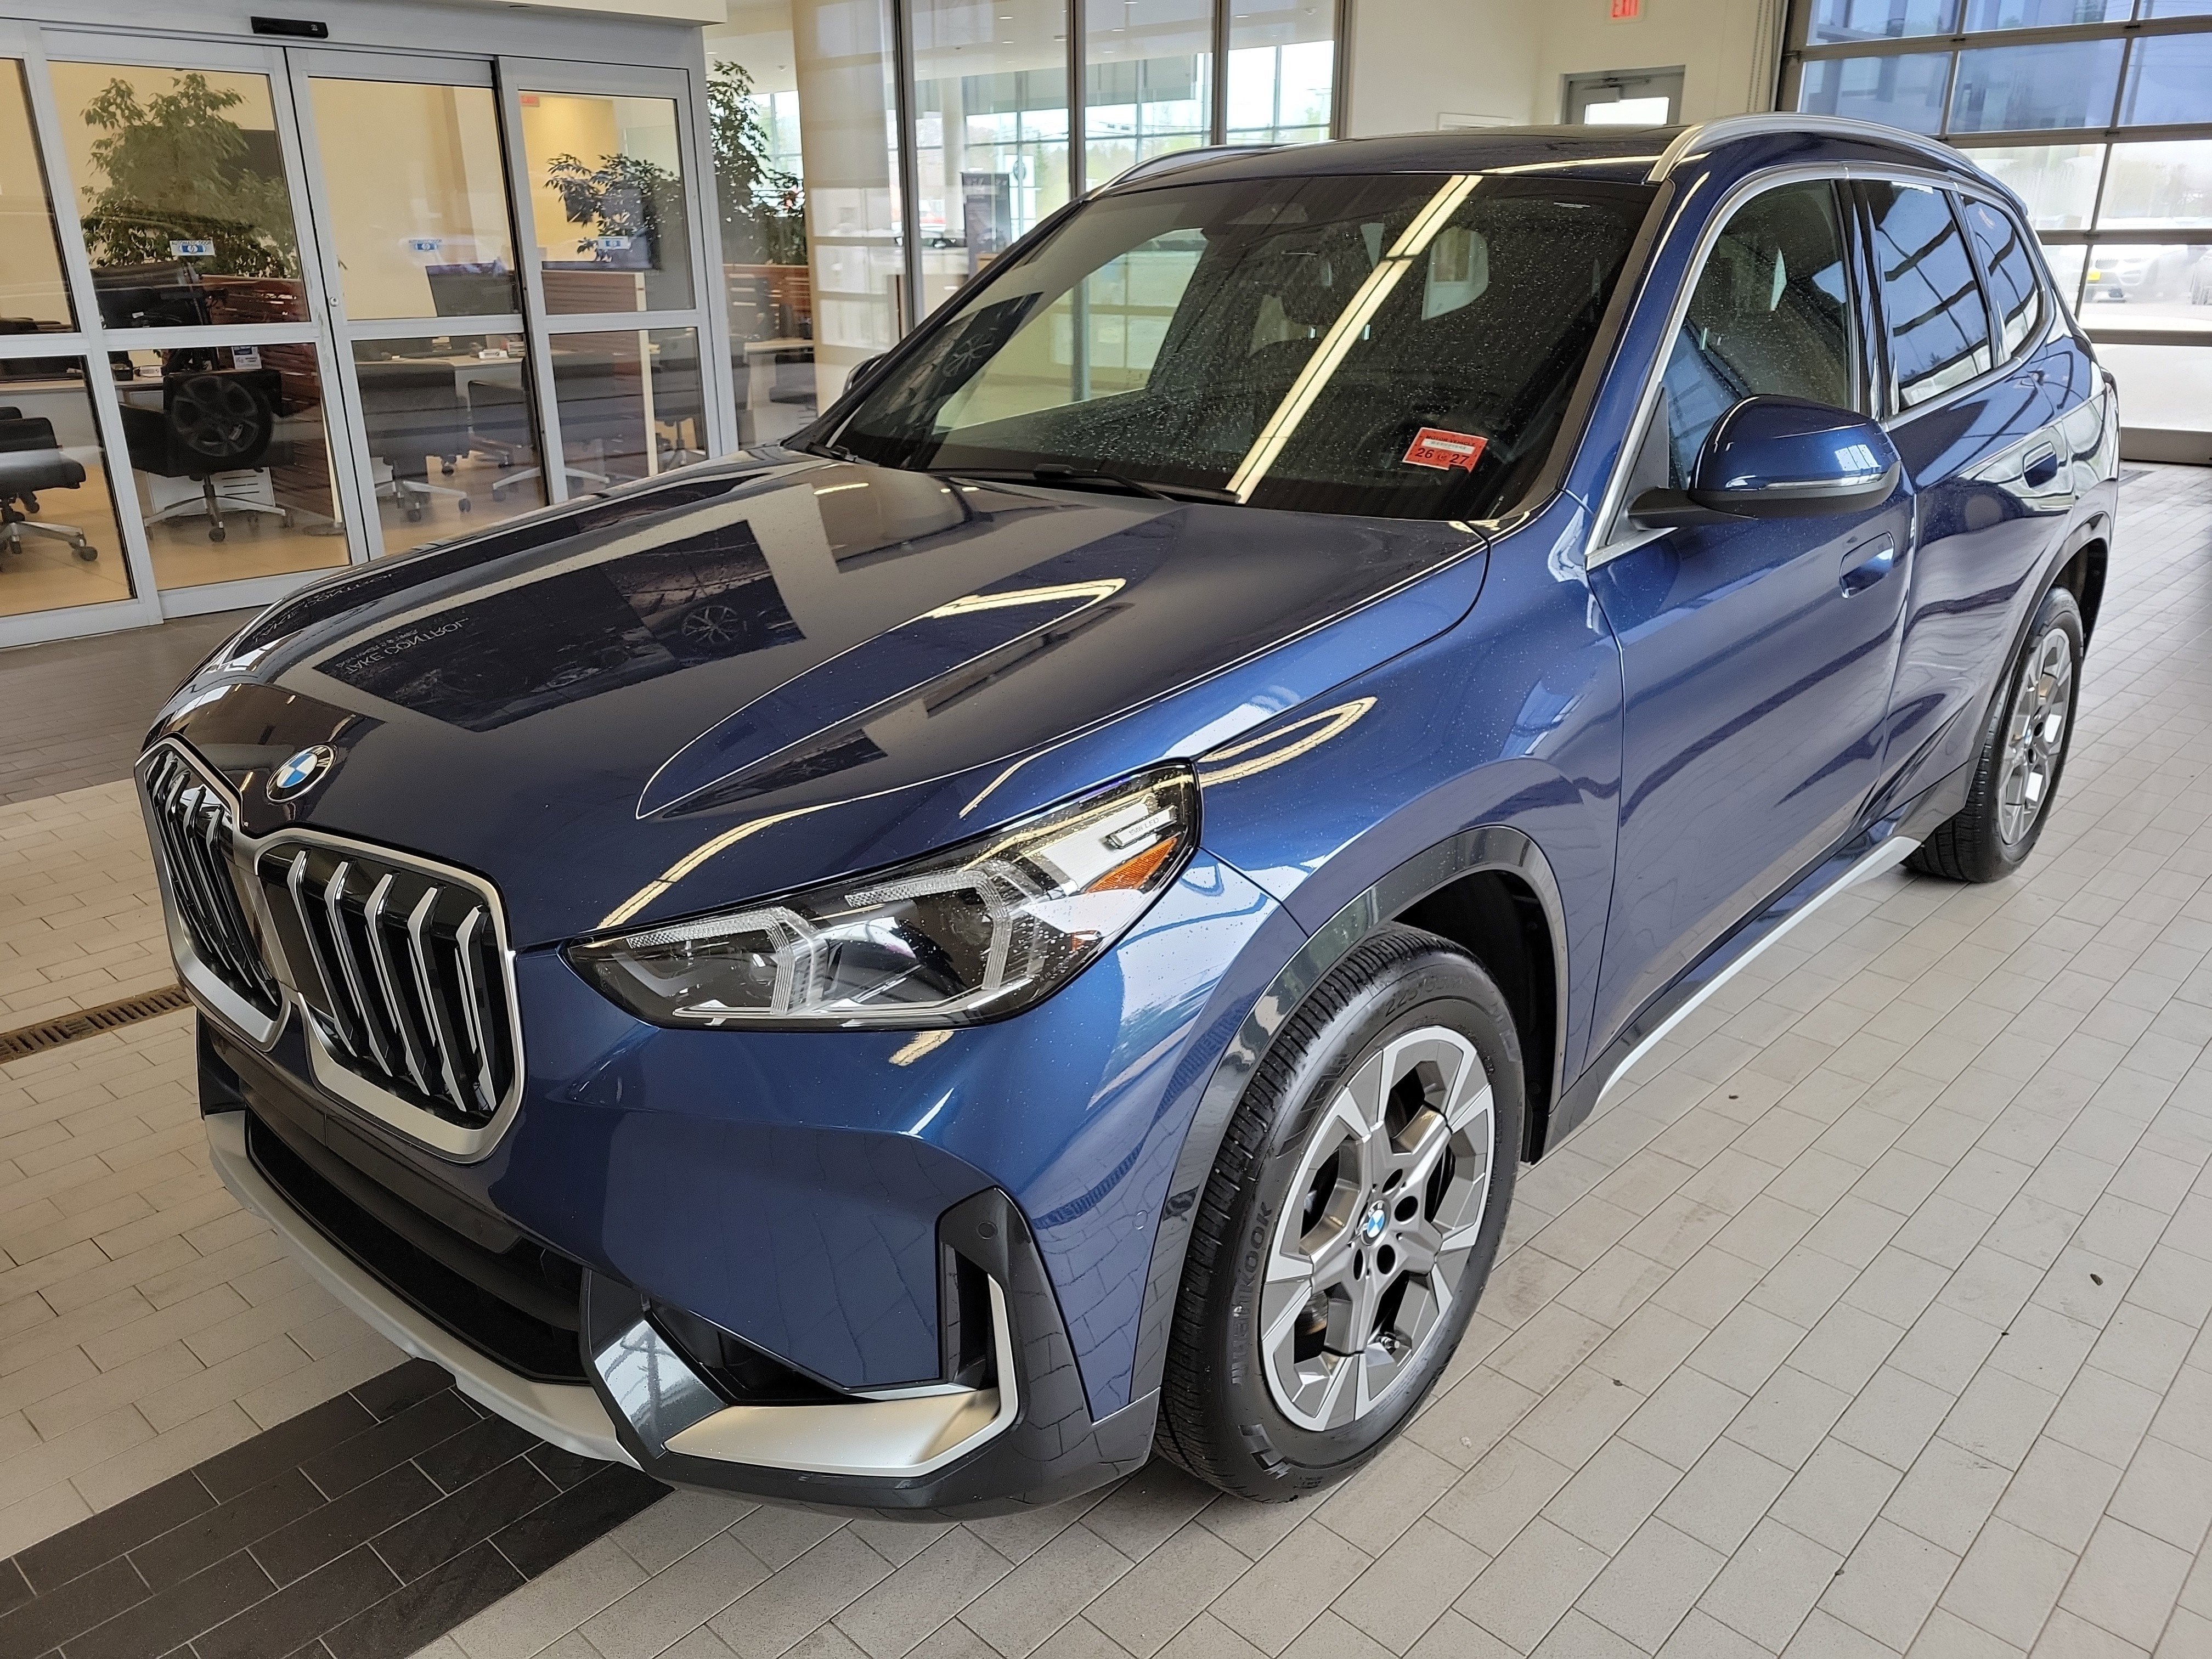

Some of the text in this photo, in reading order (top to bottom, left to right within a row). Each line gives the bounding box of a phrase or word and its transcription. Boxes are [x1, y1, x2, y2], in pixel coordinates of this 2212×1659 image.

[1415, 448, 1470, 465] 26 27
[1144, 817, 1159, 828] LED
